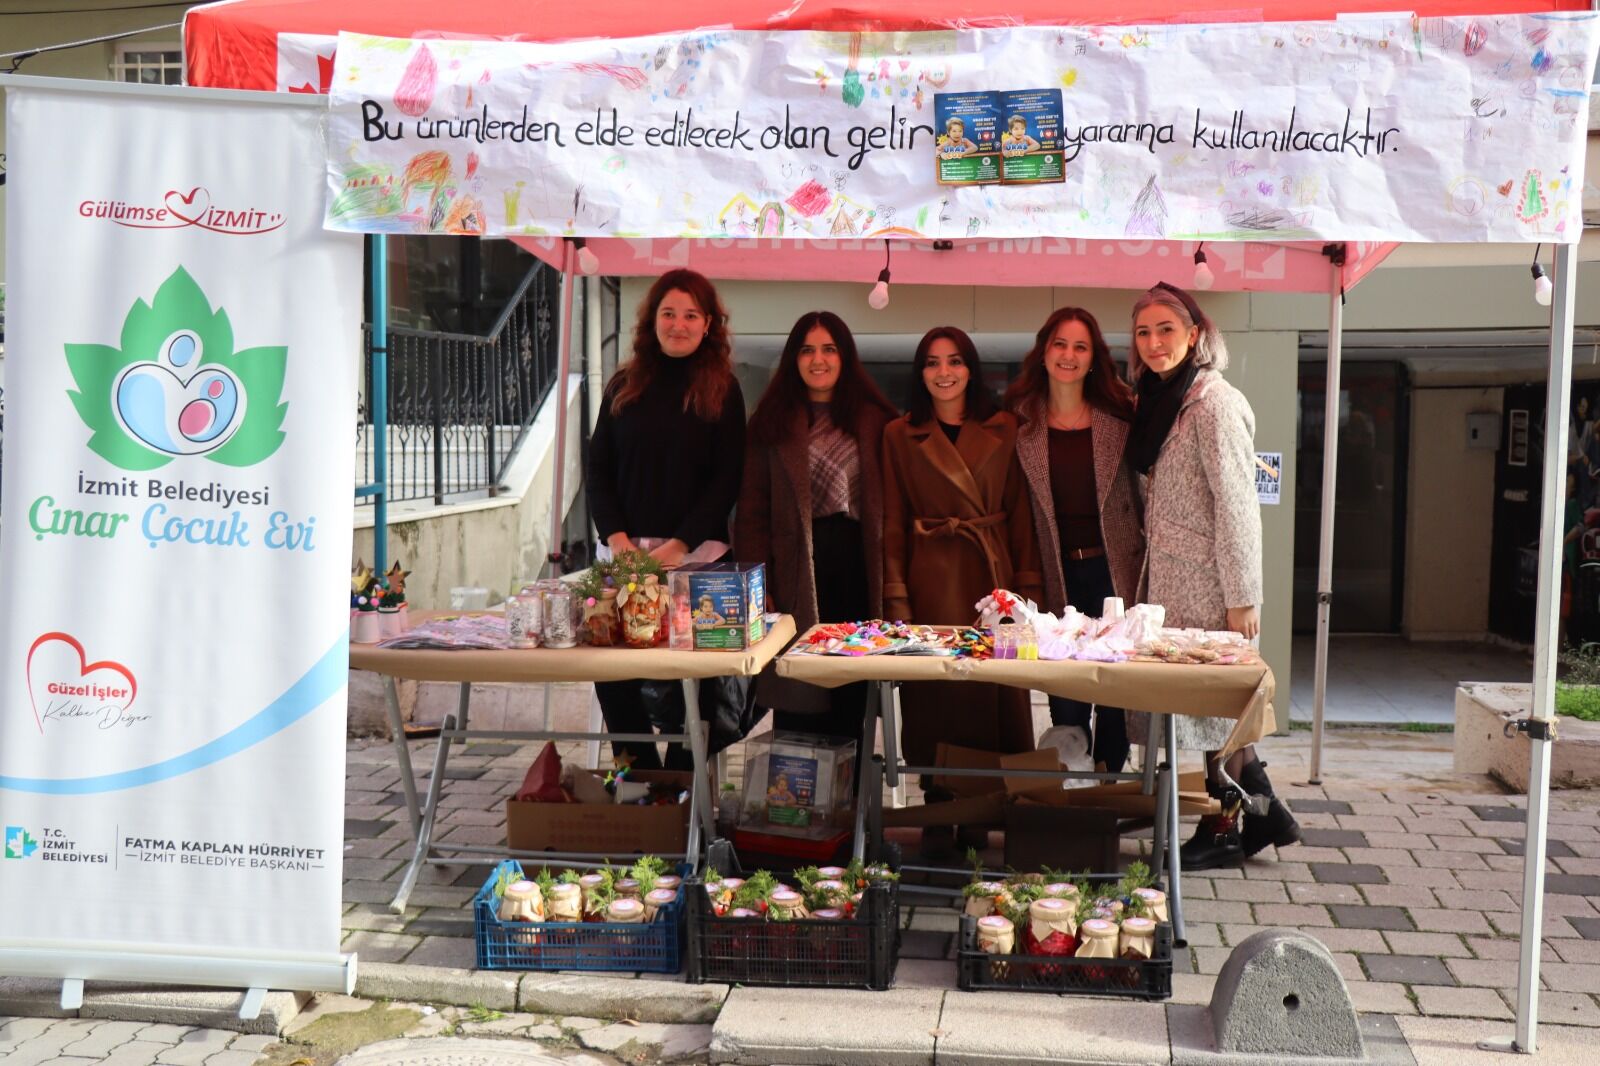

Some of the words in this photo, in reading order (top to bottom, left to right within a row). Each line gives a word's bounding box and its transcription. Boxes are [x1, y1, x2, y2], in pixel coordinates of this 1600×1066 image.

[361, 99, 403, 142] Bu
[416, 104, 566, 147] ürünlerden
[575, 107, 634, 146] elde
[645, 107, 753, 150] edilecek
[760, 103, 838, 157] olan
[847, 105, 933, 170] gelir
[1065, 122, 1174, 163] yararına
[1192, 106, 1401, 158] kullanılacaktır.
[79, 200, 168, 223] Gülümse
[206, 204, 267, 228] İZMİT
[1255, 469, 1280, 483] URSU
[78, 470, 139, 498] İzmit
[147, 480, 270, 509] Belediyesi
[28, 495, 129, 541] Çınar
[141, 503, 250, 549] Çocuk
[264, 510, 316, 552] Evi
[47, 682, 89, 696] Güzel
[92, 683, 128, 701] İşler
[43, 700, 96, 723] Kalbe
[42, 828, 67, 838] T.C.
[42, 838, 76, 850] İZMİT
[125, 837, 176, 851] FATMA
[181, 839, 244, 855] KAPLAN
[249, 841, 325, 861] HÜRRİYET
[42, 850, 108, 864] BELEDİYESİ
[180, 853, 246, 868] BELEDİYE
